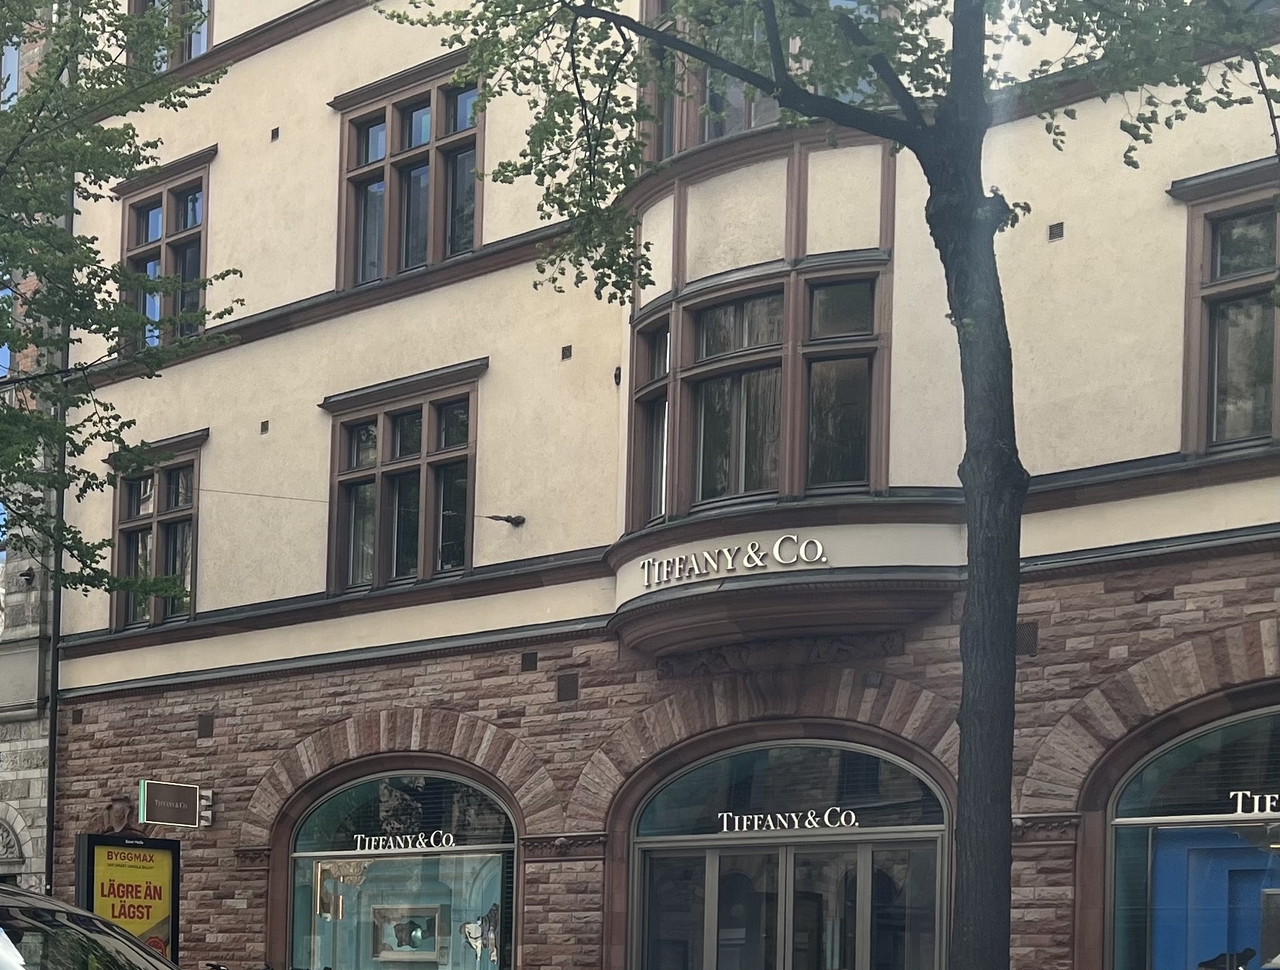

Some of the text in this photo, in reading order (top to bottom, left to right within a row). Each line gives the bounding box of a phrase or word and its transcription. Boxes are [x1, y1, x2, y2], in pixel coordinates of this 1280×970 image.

[640, 546, 741, 588] TIFFANY
[743, 541, 768, 568] &
[718, 811, 803, 832] TIFFANY
[804, 809, 821, 829] &
[353, 834, 416, 851] TIFFANY
[416, 832, 429, 848] &
[107, 851, 155, 863] BYGGMAX
[101, 879, 162, 901] LÄGRE ÄN
[111, 900, 152, 920] LÄGST
